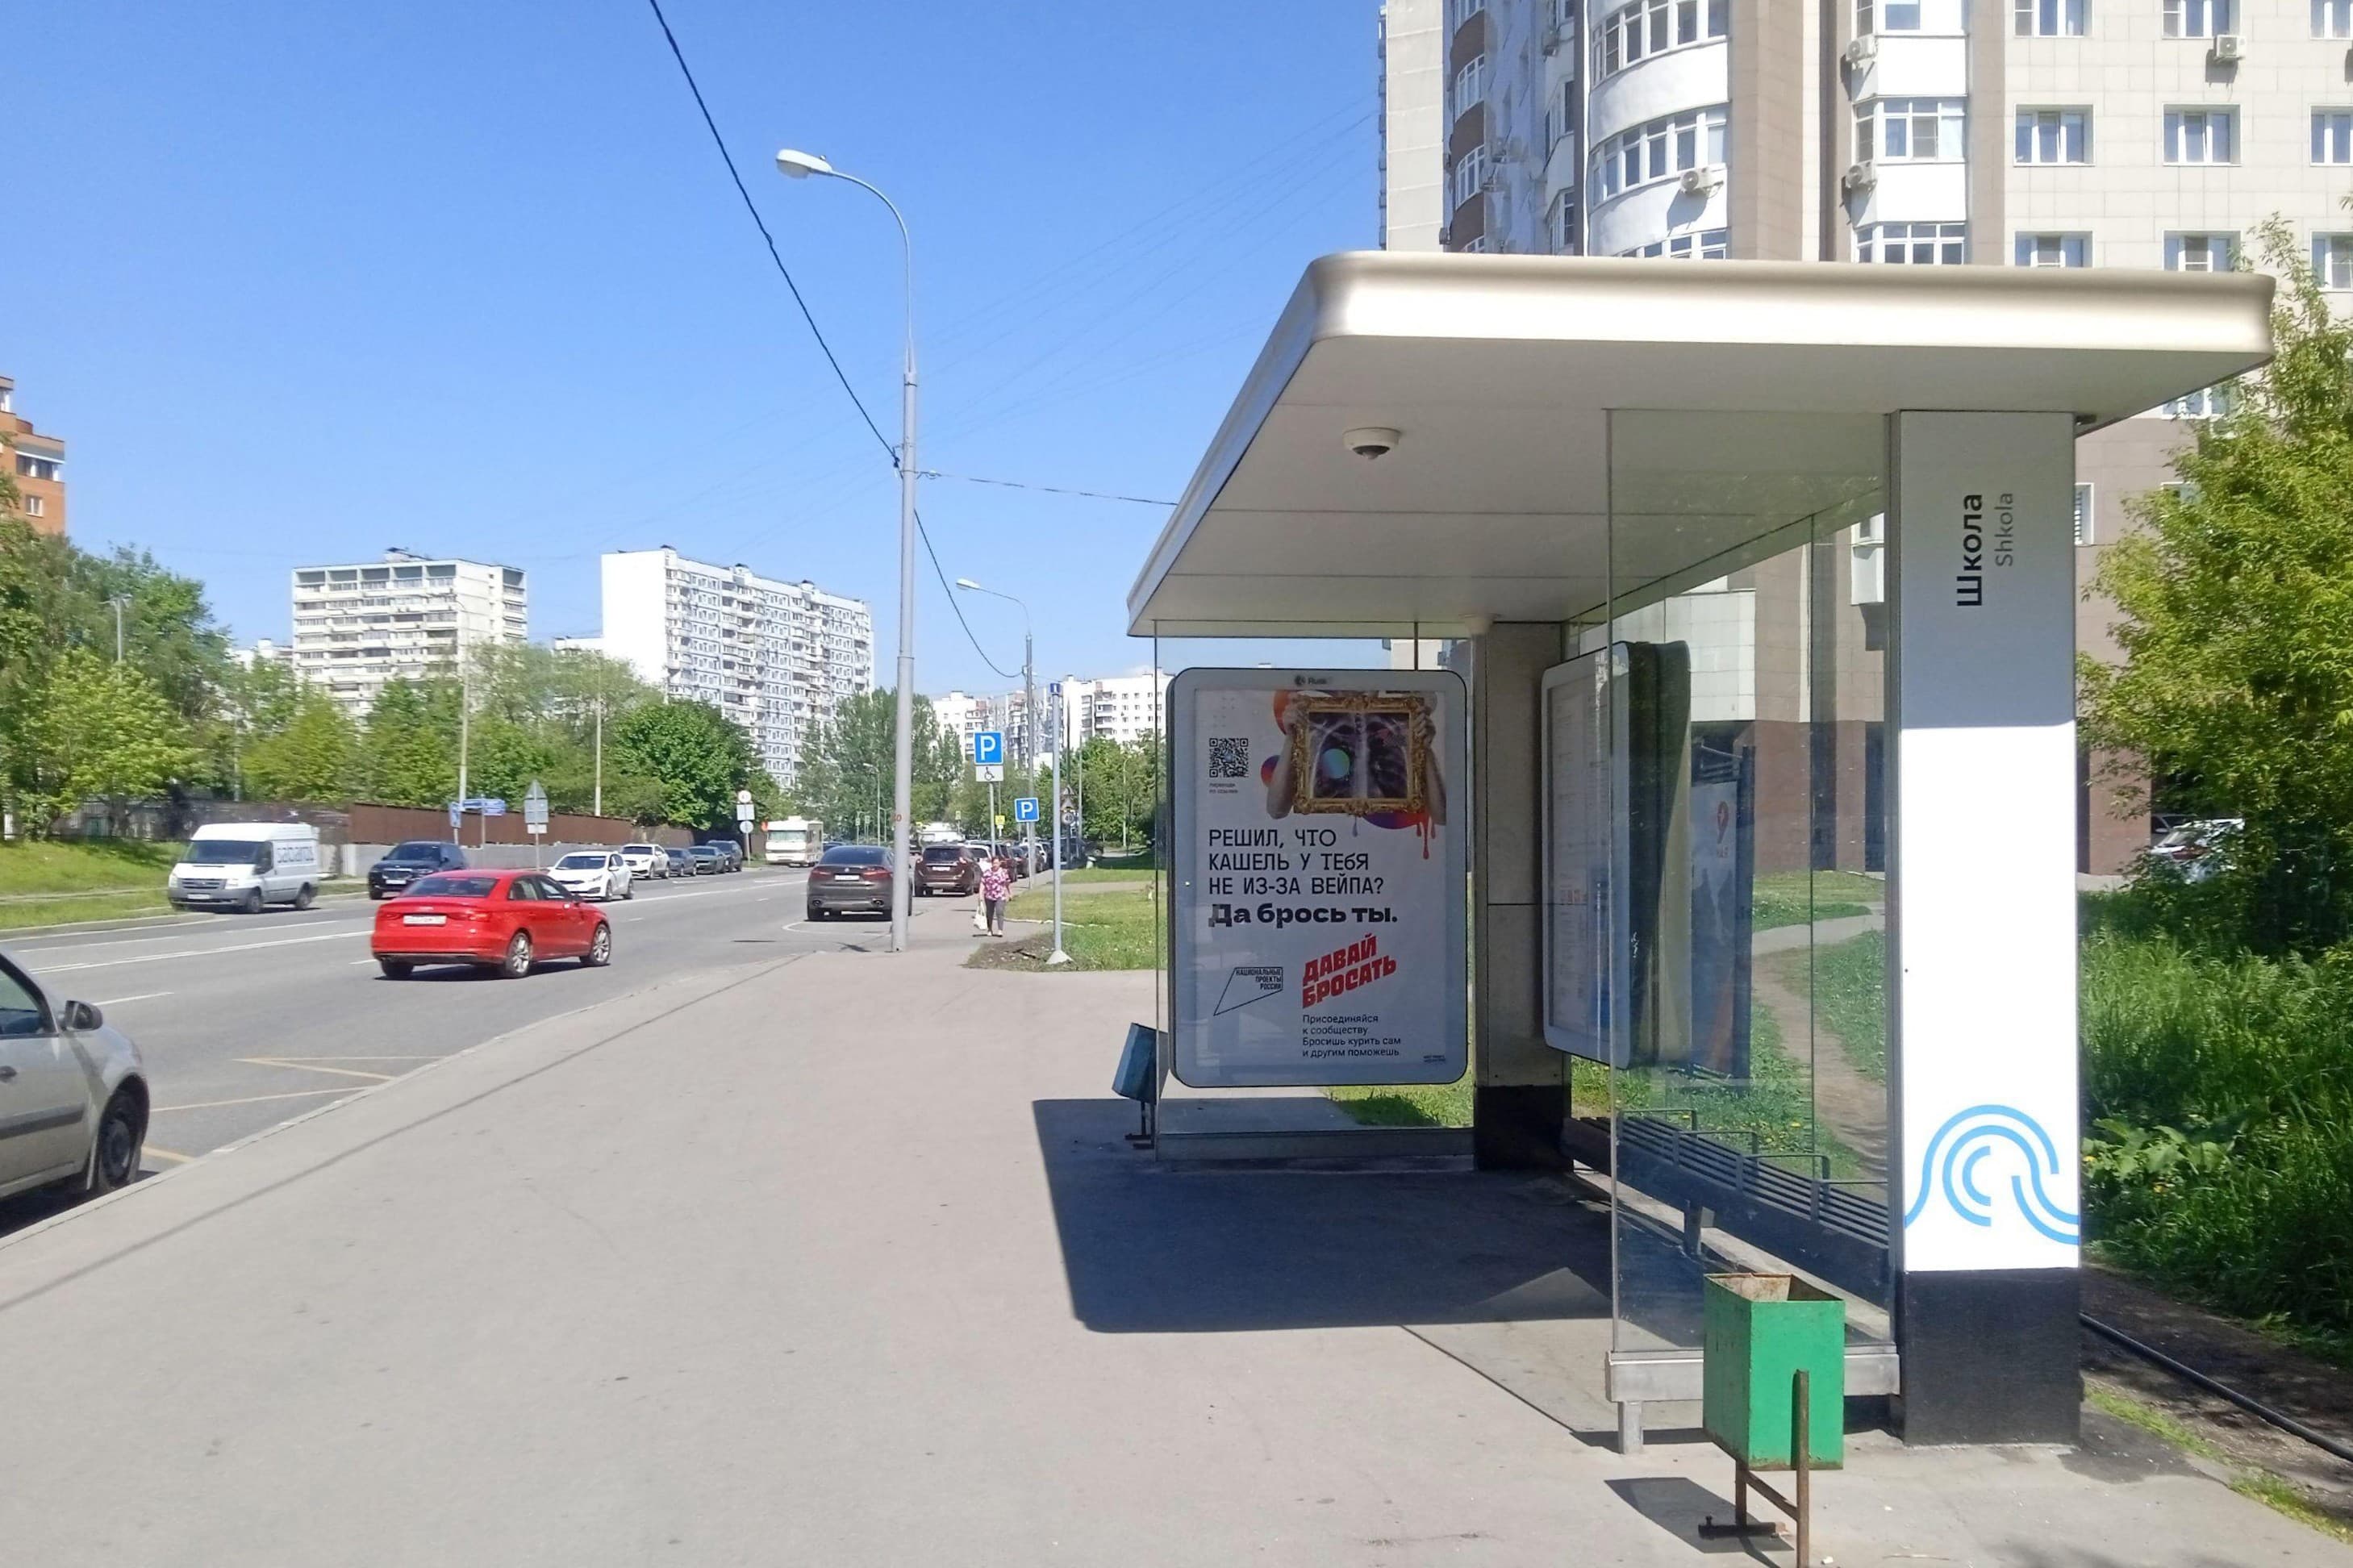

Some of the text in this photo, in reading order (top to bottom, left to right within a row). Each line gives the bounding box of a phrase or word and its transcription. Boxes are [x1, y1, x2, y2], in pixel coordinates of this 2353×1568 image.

[1994, 493, 2013, 566] Shkola
[1956, 494, 1982, 607] Школа
[980, 735, 996, 761] P
[1020, 801, 1033, 819] P
[1209, 829, 1337, 849] РЕШИЛ, ЧТО
[1209, 853, 1290, 870] КАШЕЛЬ
[1300, 853, 1311, 870] У
[1209, 874, 1384, 895] НЕ ИЗ-ЗА ВЕЙПА?
[1208, 903, 1398, 928] Да брось ты.
[1303, 933, 1376, 986] ДАВАЙ
[1303, 955, 1396, 1009] БРОСАТЬ
[1303, 1015, 1379, 1024] Присоединяйся
[1303, 1037, 1345, 1047] Бросишь
[1348, 1038, 1380, 1046] курить
[1310, 1050, 1345, 1058] другим
